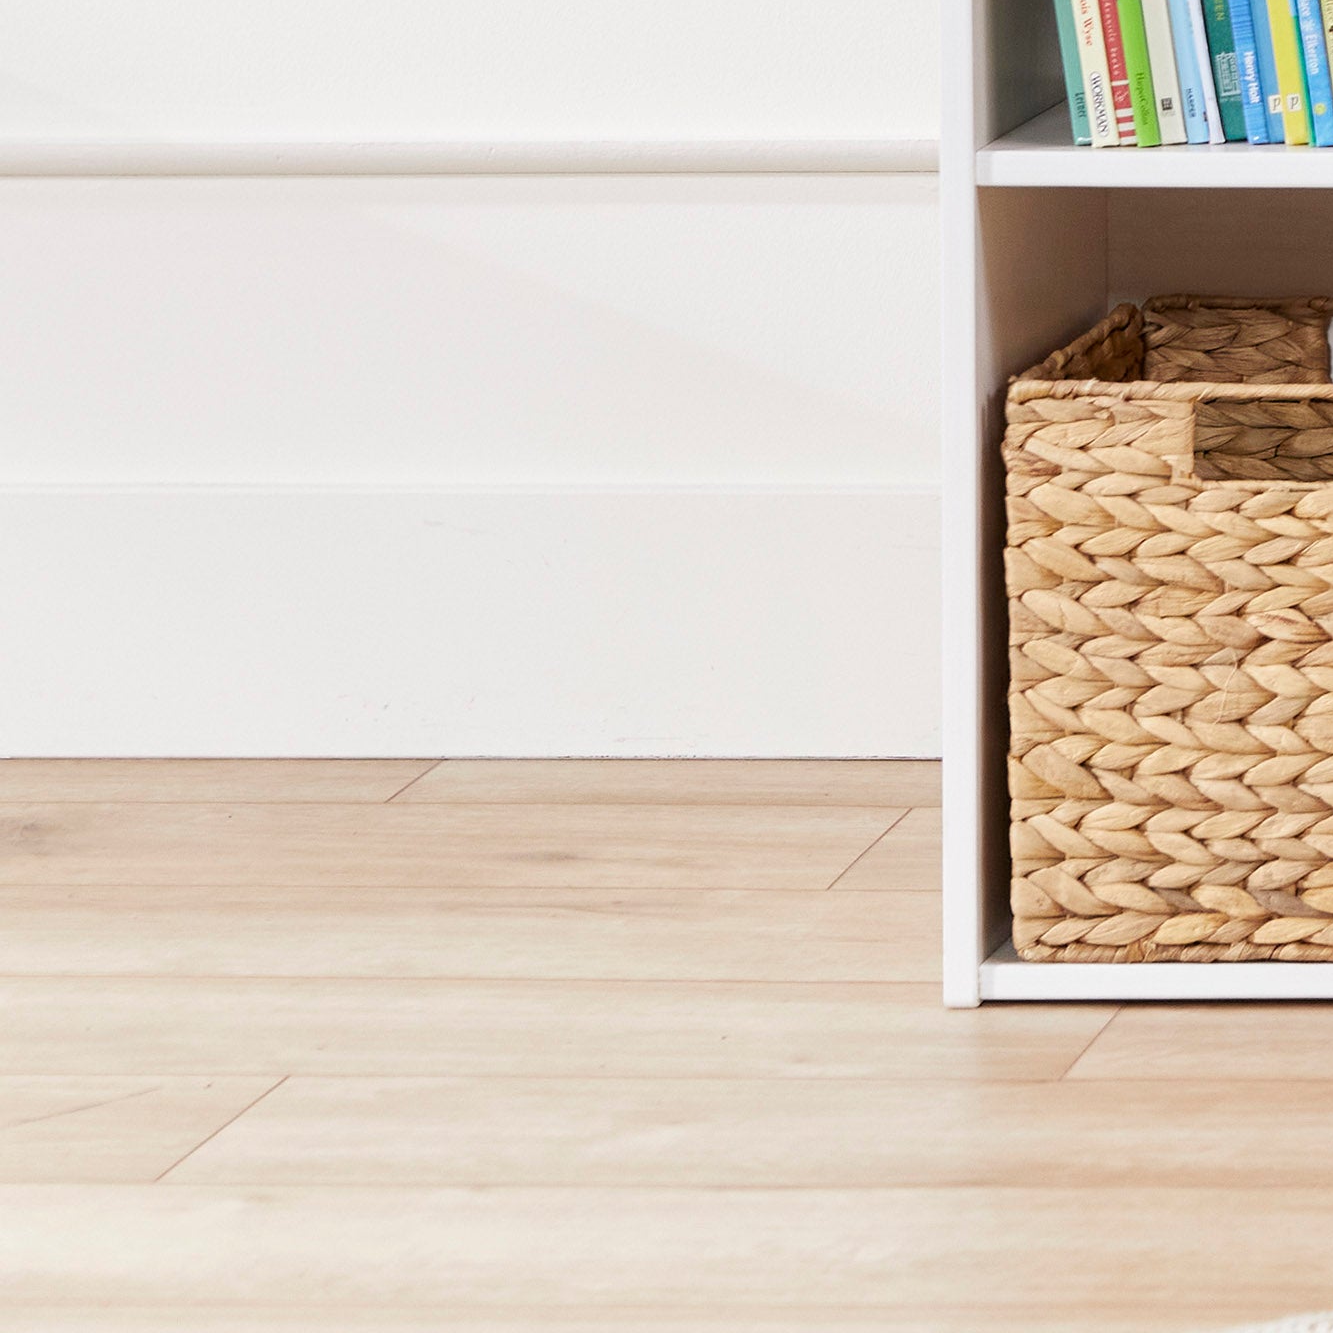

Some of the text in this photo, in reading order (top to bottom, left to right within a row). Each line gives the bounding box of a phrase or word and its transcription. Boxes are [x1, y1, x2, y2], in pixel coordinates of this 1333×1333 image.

[1243, 51, 1261, 103] Henry Holt
[1305, 34, 1319, 76] Elkerton
[1091, 75, 1108, 133] WORKMAN
